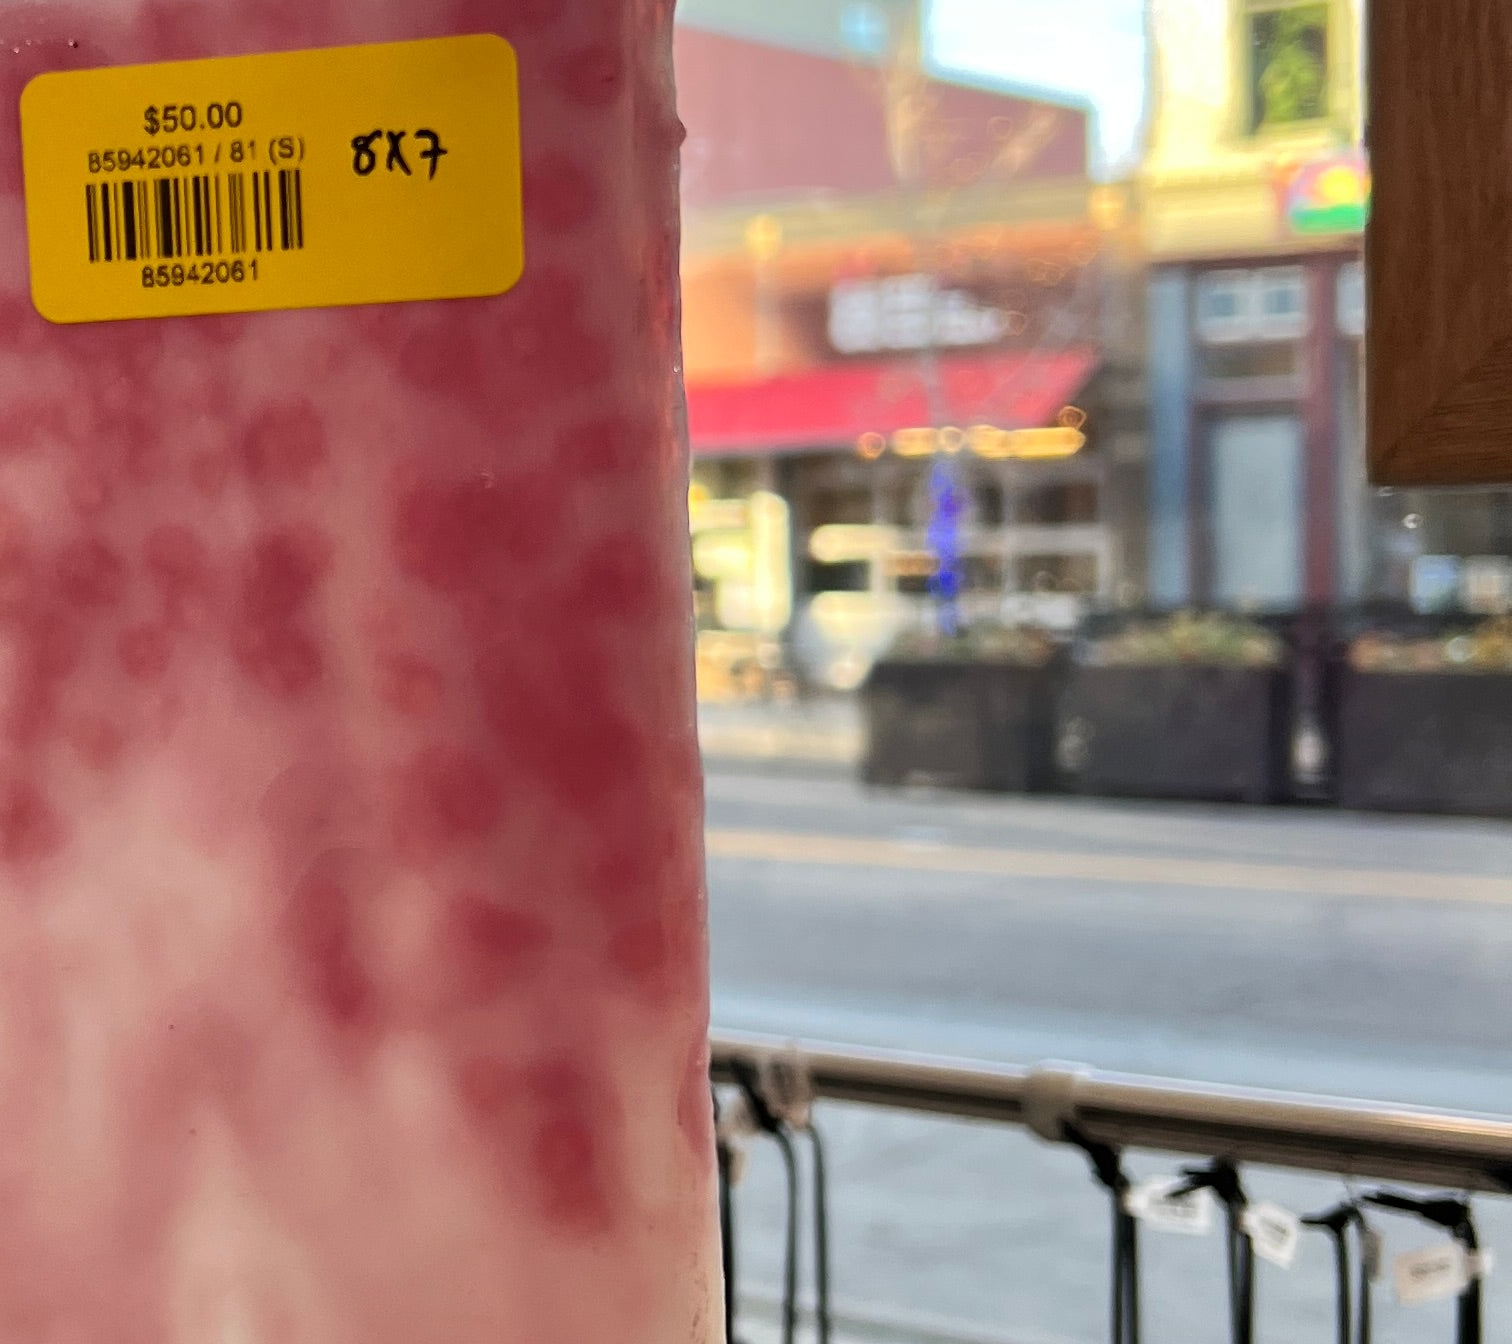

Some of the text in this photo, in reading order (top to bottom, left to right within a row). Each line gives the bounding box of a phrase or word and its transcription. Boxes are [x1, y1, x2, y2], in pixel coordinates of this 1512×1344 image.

[143, 101, 244, 136] $50.00
[88, 142, 205, 175] 85942061
[230, 139, 257, 163] 81
[268, 134, 305, 166] (S)
[141, 258, 259, 288] 85942061
